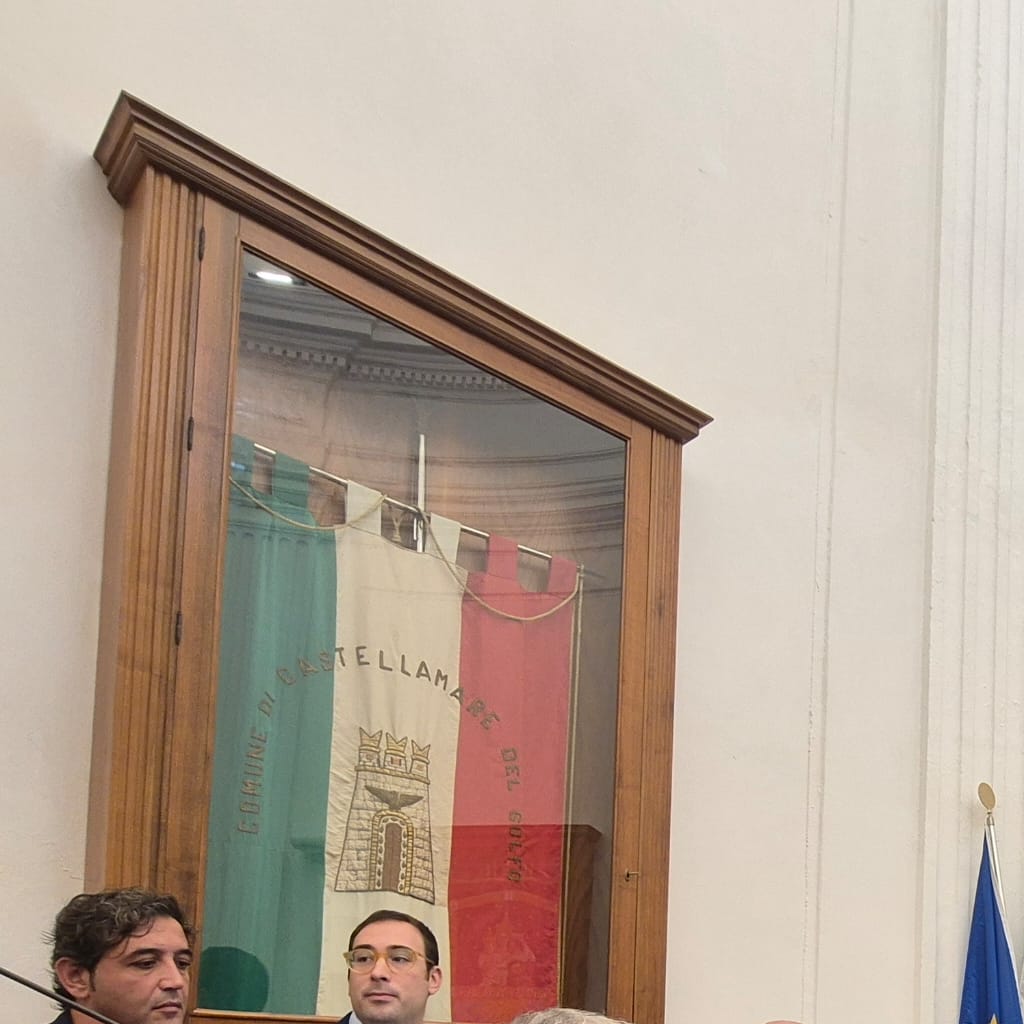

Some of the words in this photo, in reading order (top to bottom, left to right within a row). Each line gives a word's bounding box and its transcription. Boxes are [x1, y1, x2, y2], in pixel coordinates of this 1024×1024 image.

[257, 691, 275, 717] DI
[276, 646, 500, 730] CASTELLAMARE
[237, 725, 267, 835] COMUNE
[501, 748, 520, 791] DEL
[508, 811, 522, 882] GOLFO
